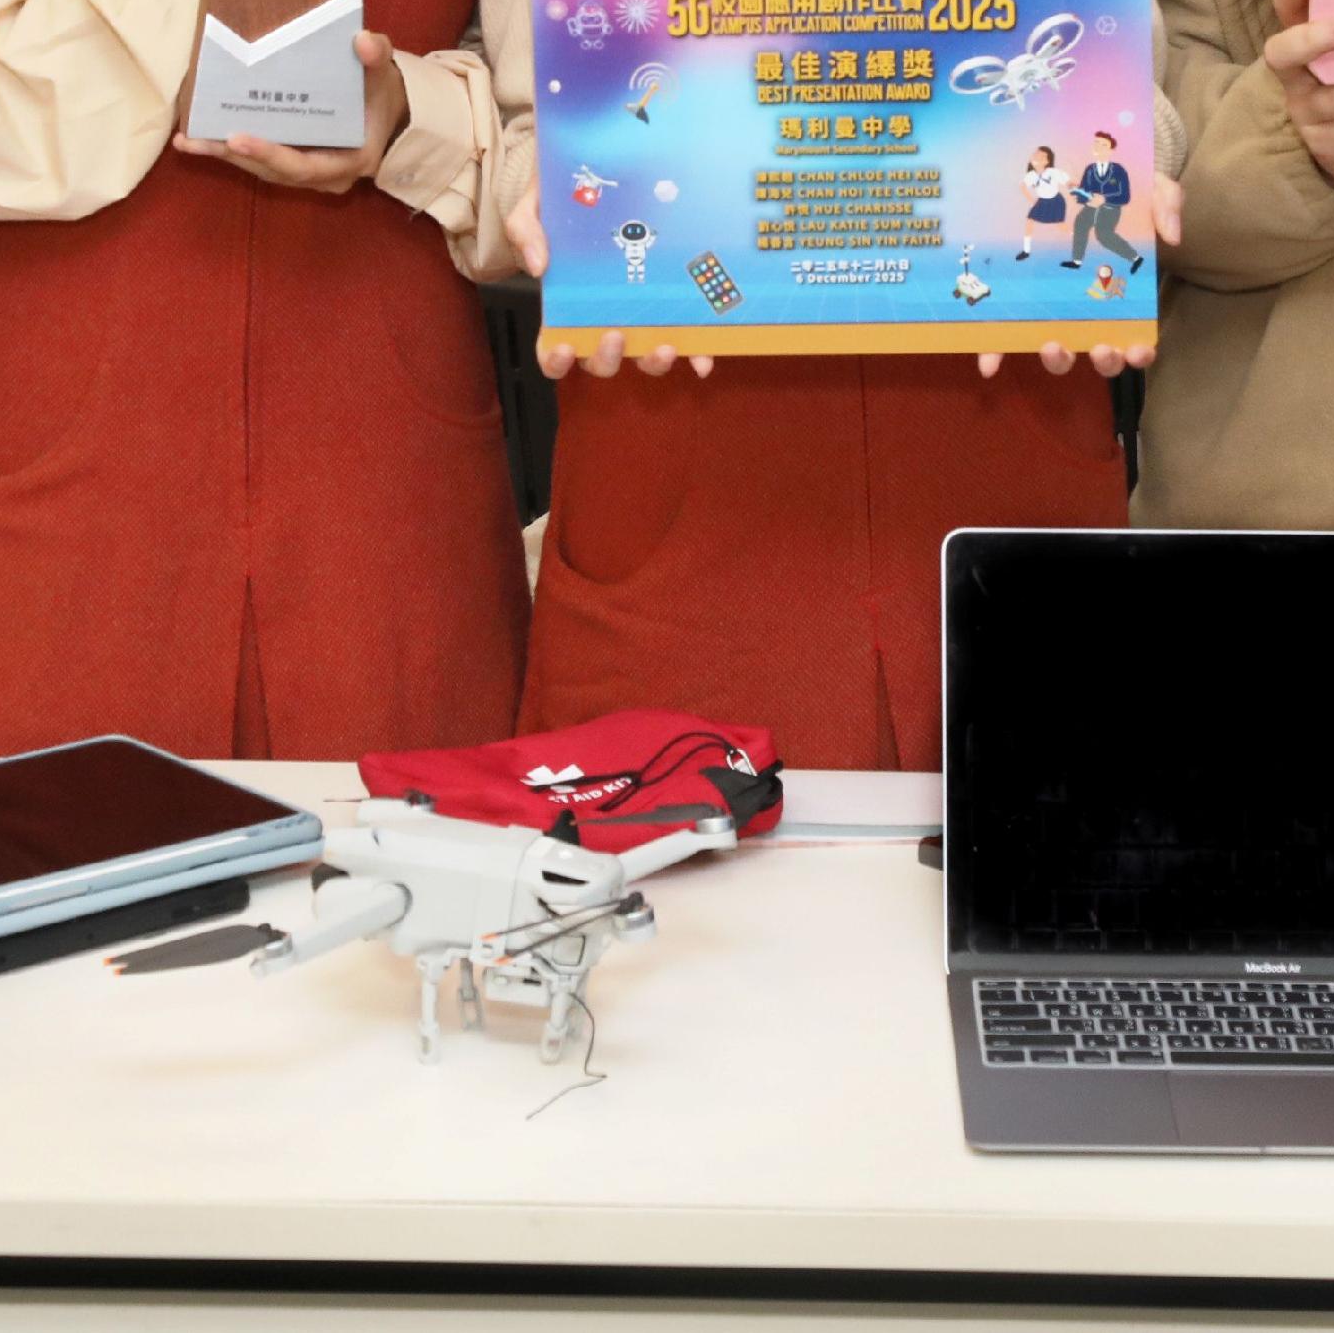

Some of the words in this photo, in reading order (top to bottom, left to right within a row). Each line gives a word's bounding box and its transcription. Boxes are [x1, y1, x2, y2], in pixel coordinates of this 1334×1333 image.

[712, 16, 762, 35] CAMPUS
[766, 16, 842, 34] APPLICATION
[844, 14, 924, 32] COMPETITION
[755, 49, 933, 82] 最佳演繹獎
[758, 85, 788, 103] BEST
[792, 83, 883, 102] PRESENTATION
[886, 82, 932, 101] AWARD
[780, 115, 912, 139] 瑪利曼中學
[798, 171, 835, 182] CHAN
[839, 170, 883, 181] CHLOE
[888, 169, 911, 181] HEI
[915, 169, 939, 180] KIU
[798, 187, 834, 198] CHAN
[839, 187, 863, 198] HOI
[868, 187, 892, 197] YEE
[896, 186, 941, 197] CHLOE
[814, 204, 842, 215] HUE
[845, 203, 912, 214] CHARISSE
[800, 220, 826, 231] LAU
[830, 220, 868, 231] KATIE
[873, 219, 902, 230] SUM
[906, 218, 940, 229] YUET
[799, 237, 844, 248] YEUNG
[849, 236, 871, 247] SIN
[875, 235, 898, 246] YIN
[902, 234, 942, 246] FAITH
[795, 273, 804, 284] 6
[807, 272, 870, 283] December
[874, 272, 905, 283] 2025
[572, 789, 603, 802] AID
[1245, 961, 1287, 974] MacBook
[1288, 962, 1302, 974] Air
